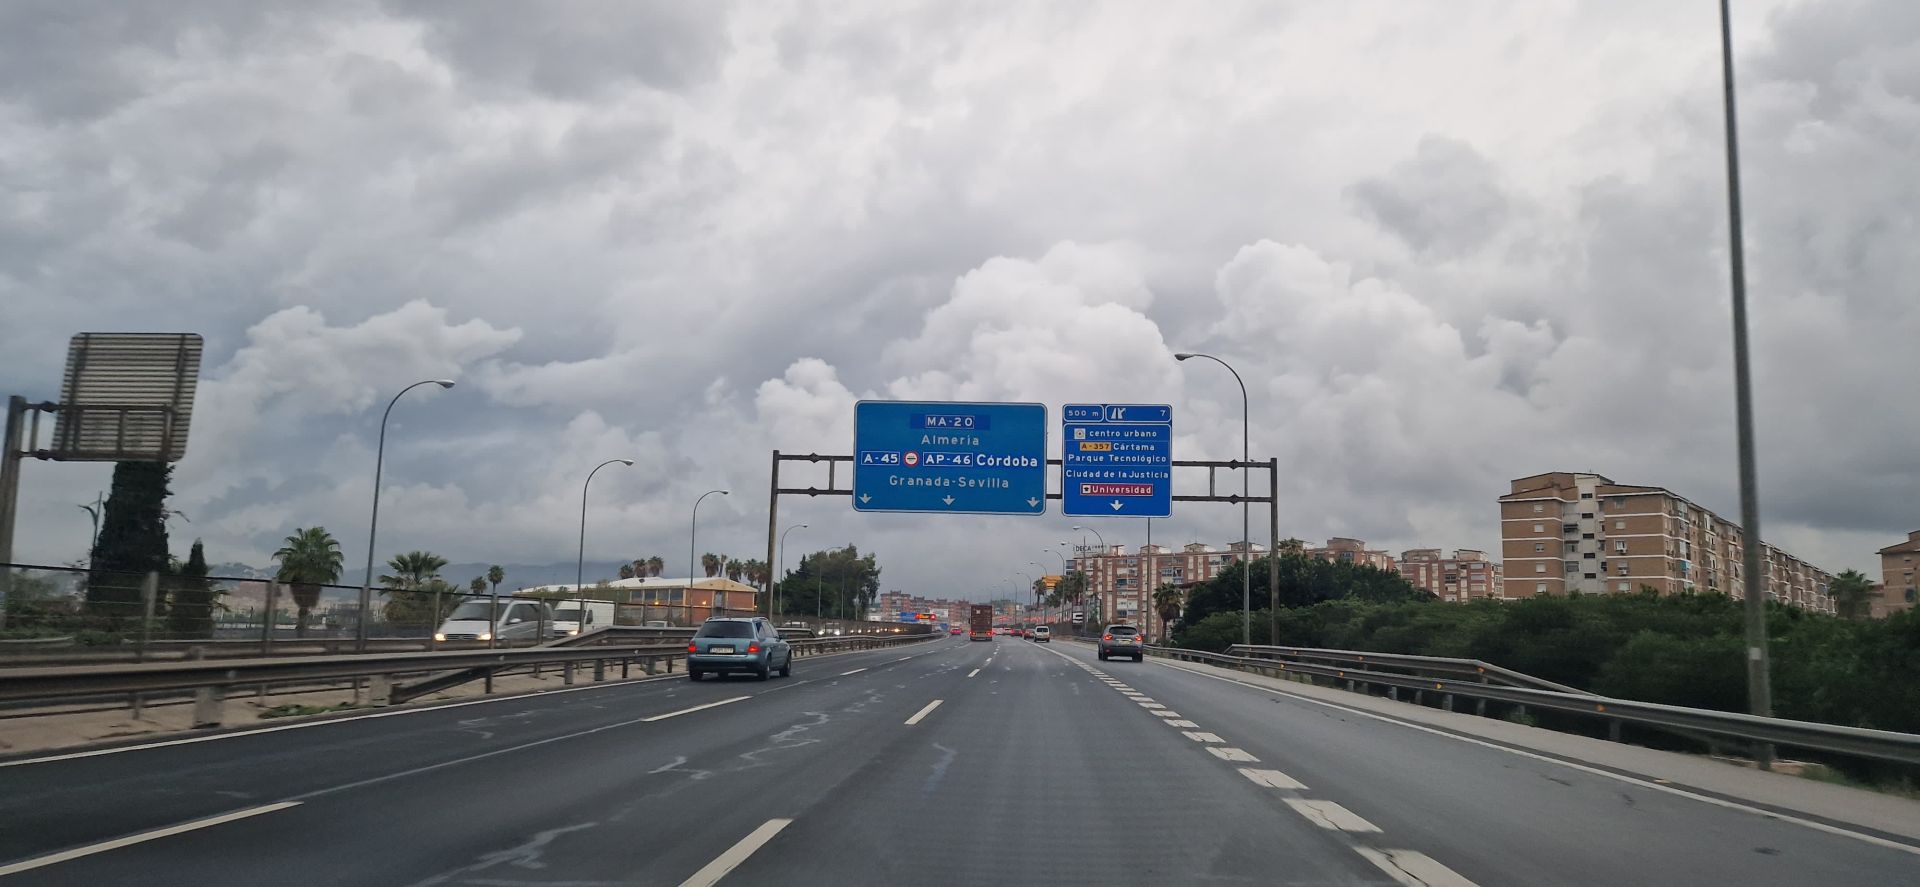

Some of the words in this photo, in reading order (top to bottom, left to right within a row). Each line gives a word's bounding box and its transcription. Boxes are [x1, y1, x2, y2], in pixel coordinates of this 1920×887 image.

[1068, 409, 1087, 417] 500
[1160, 409, 1166, 417] 7
[927, 416, 973, 427] MA-20
[863, 453, 898, 464] A-45
[925, 454, 971, 465] AP-46
[976, 454, 1038, 467] Córdoba
[1068, 454, 1104, 463] Parque
[1108, 454, 1167, 465] Tecnológico
[1066, 469, 1101, 478] Ciudad
[1118, 470, 1127, 478] la
[1128, 470, 1169, 479] Justicia
[889, 474, 1009, 489] Granada-Sevilla
[1092, 486, 1152, 494] Universidad
